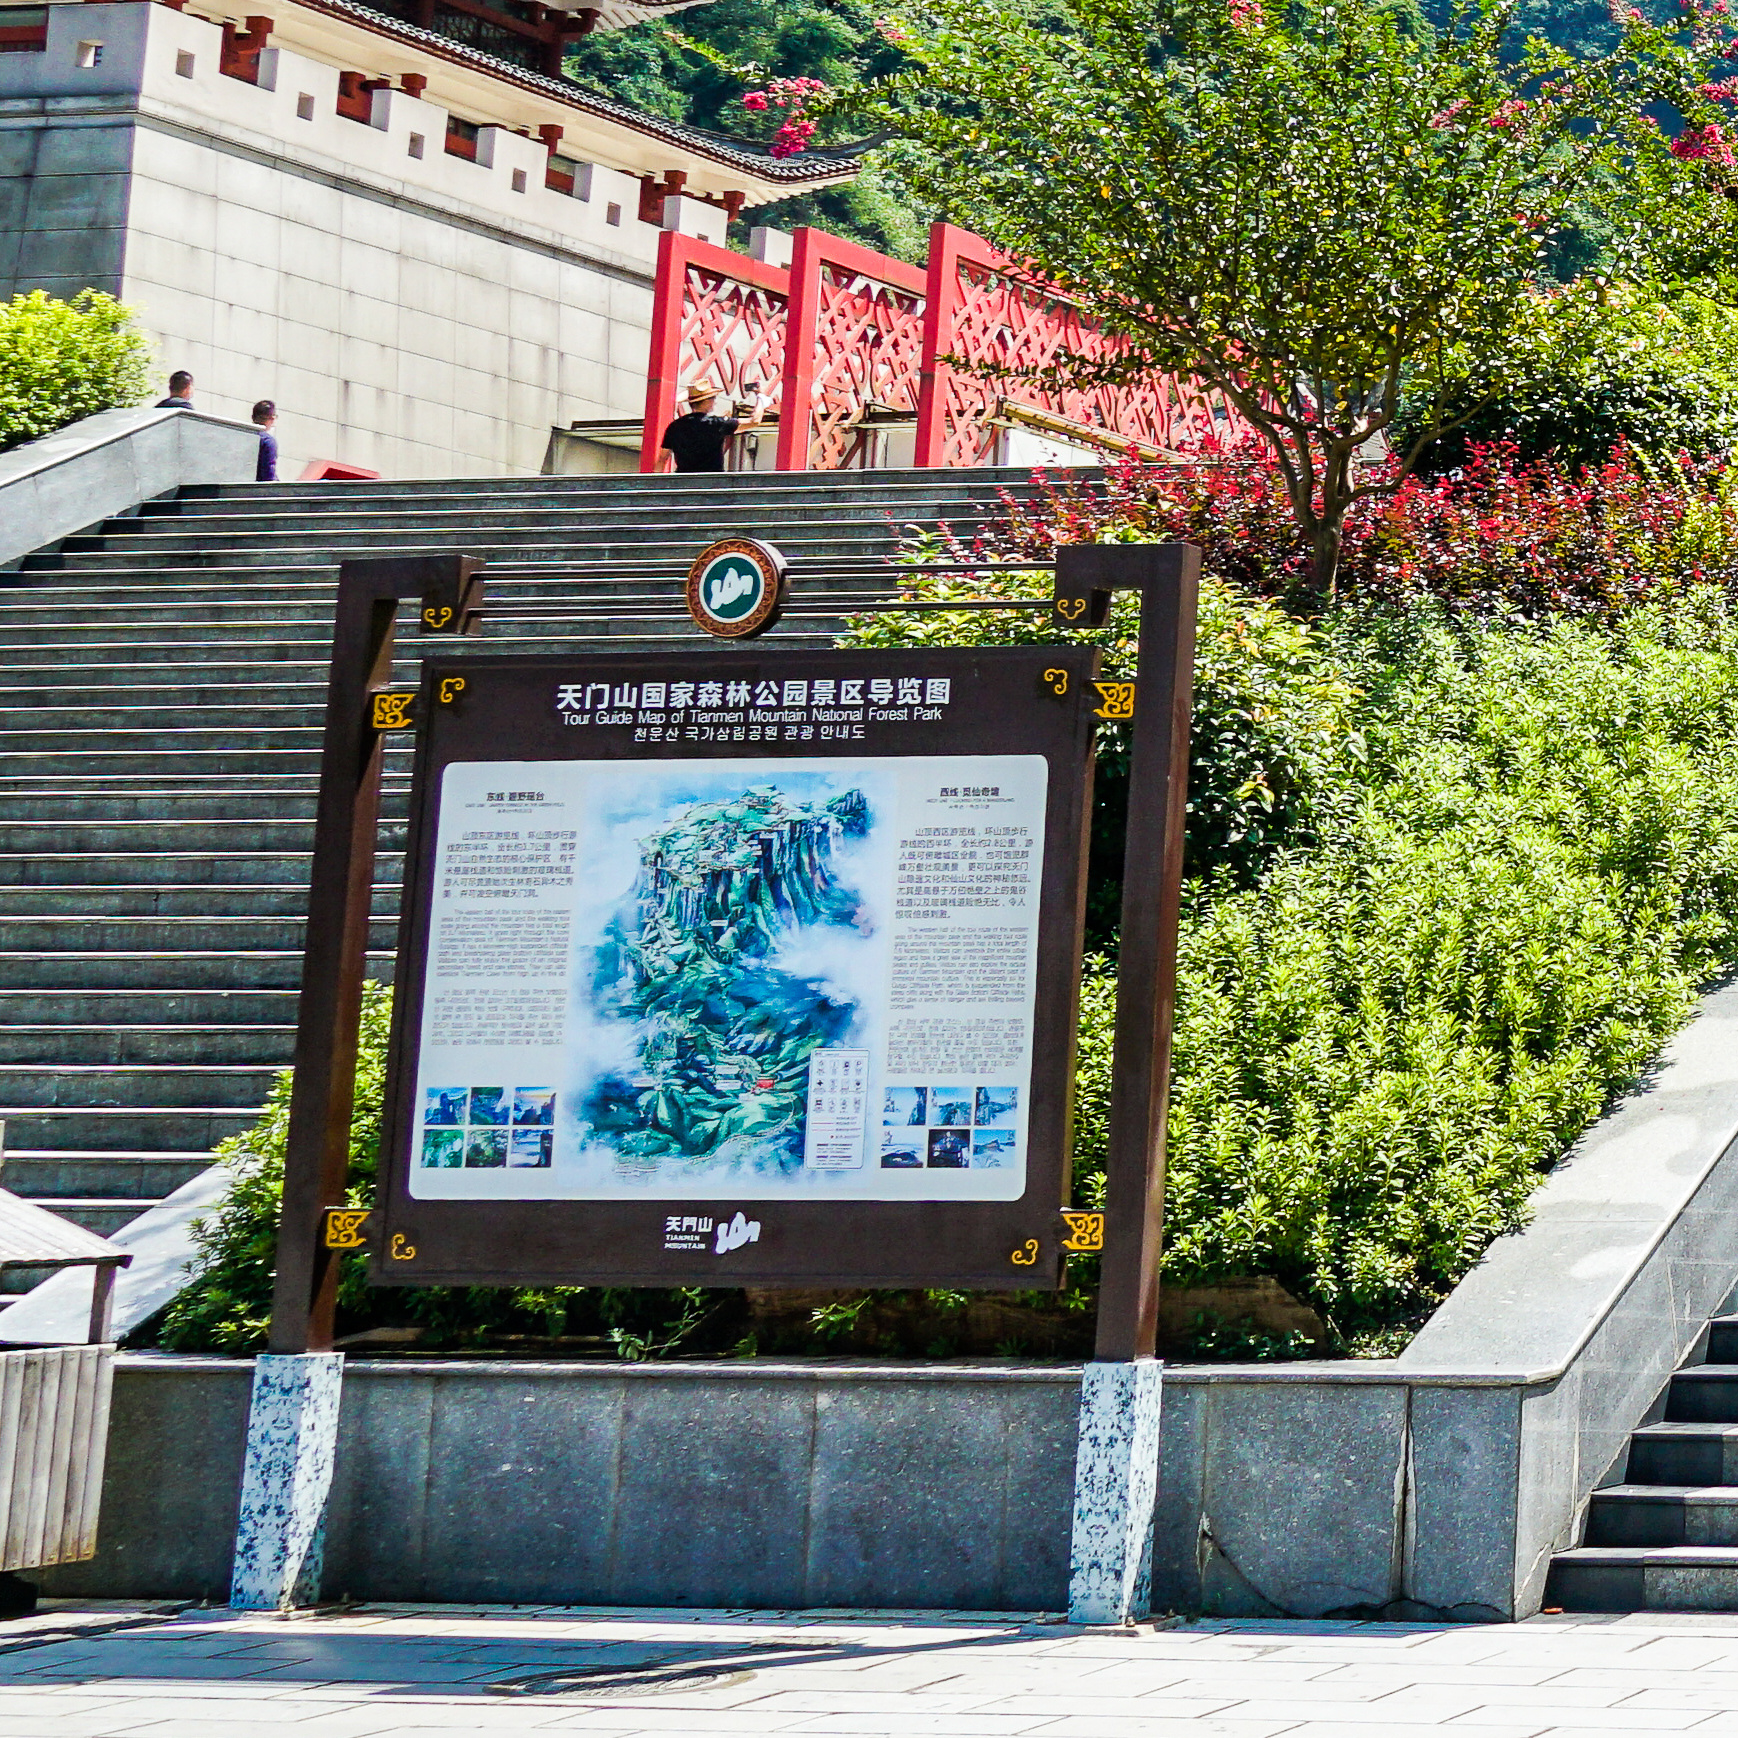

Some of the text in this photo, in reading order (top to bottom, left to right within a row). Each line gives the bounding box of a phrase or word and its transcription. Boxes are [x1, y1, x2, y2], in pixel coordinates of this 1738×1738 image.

[556, 677, 951, 710] 天门山国家森林公园景区导览图
[562, 706, 943, 725] Tour Guide Map of Tianmen Mountain National Forest Park
[634, 727, 680, 742] 천문산
[784, 725, 814, 741] 관광
[820, 724, 865, 740] 안내도
[665, 1216, 713, 1233] 天門山
